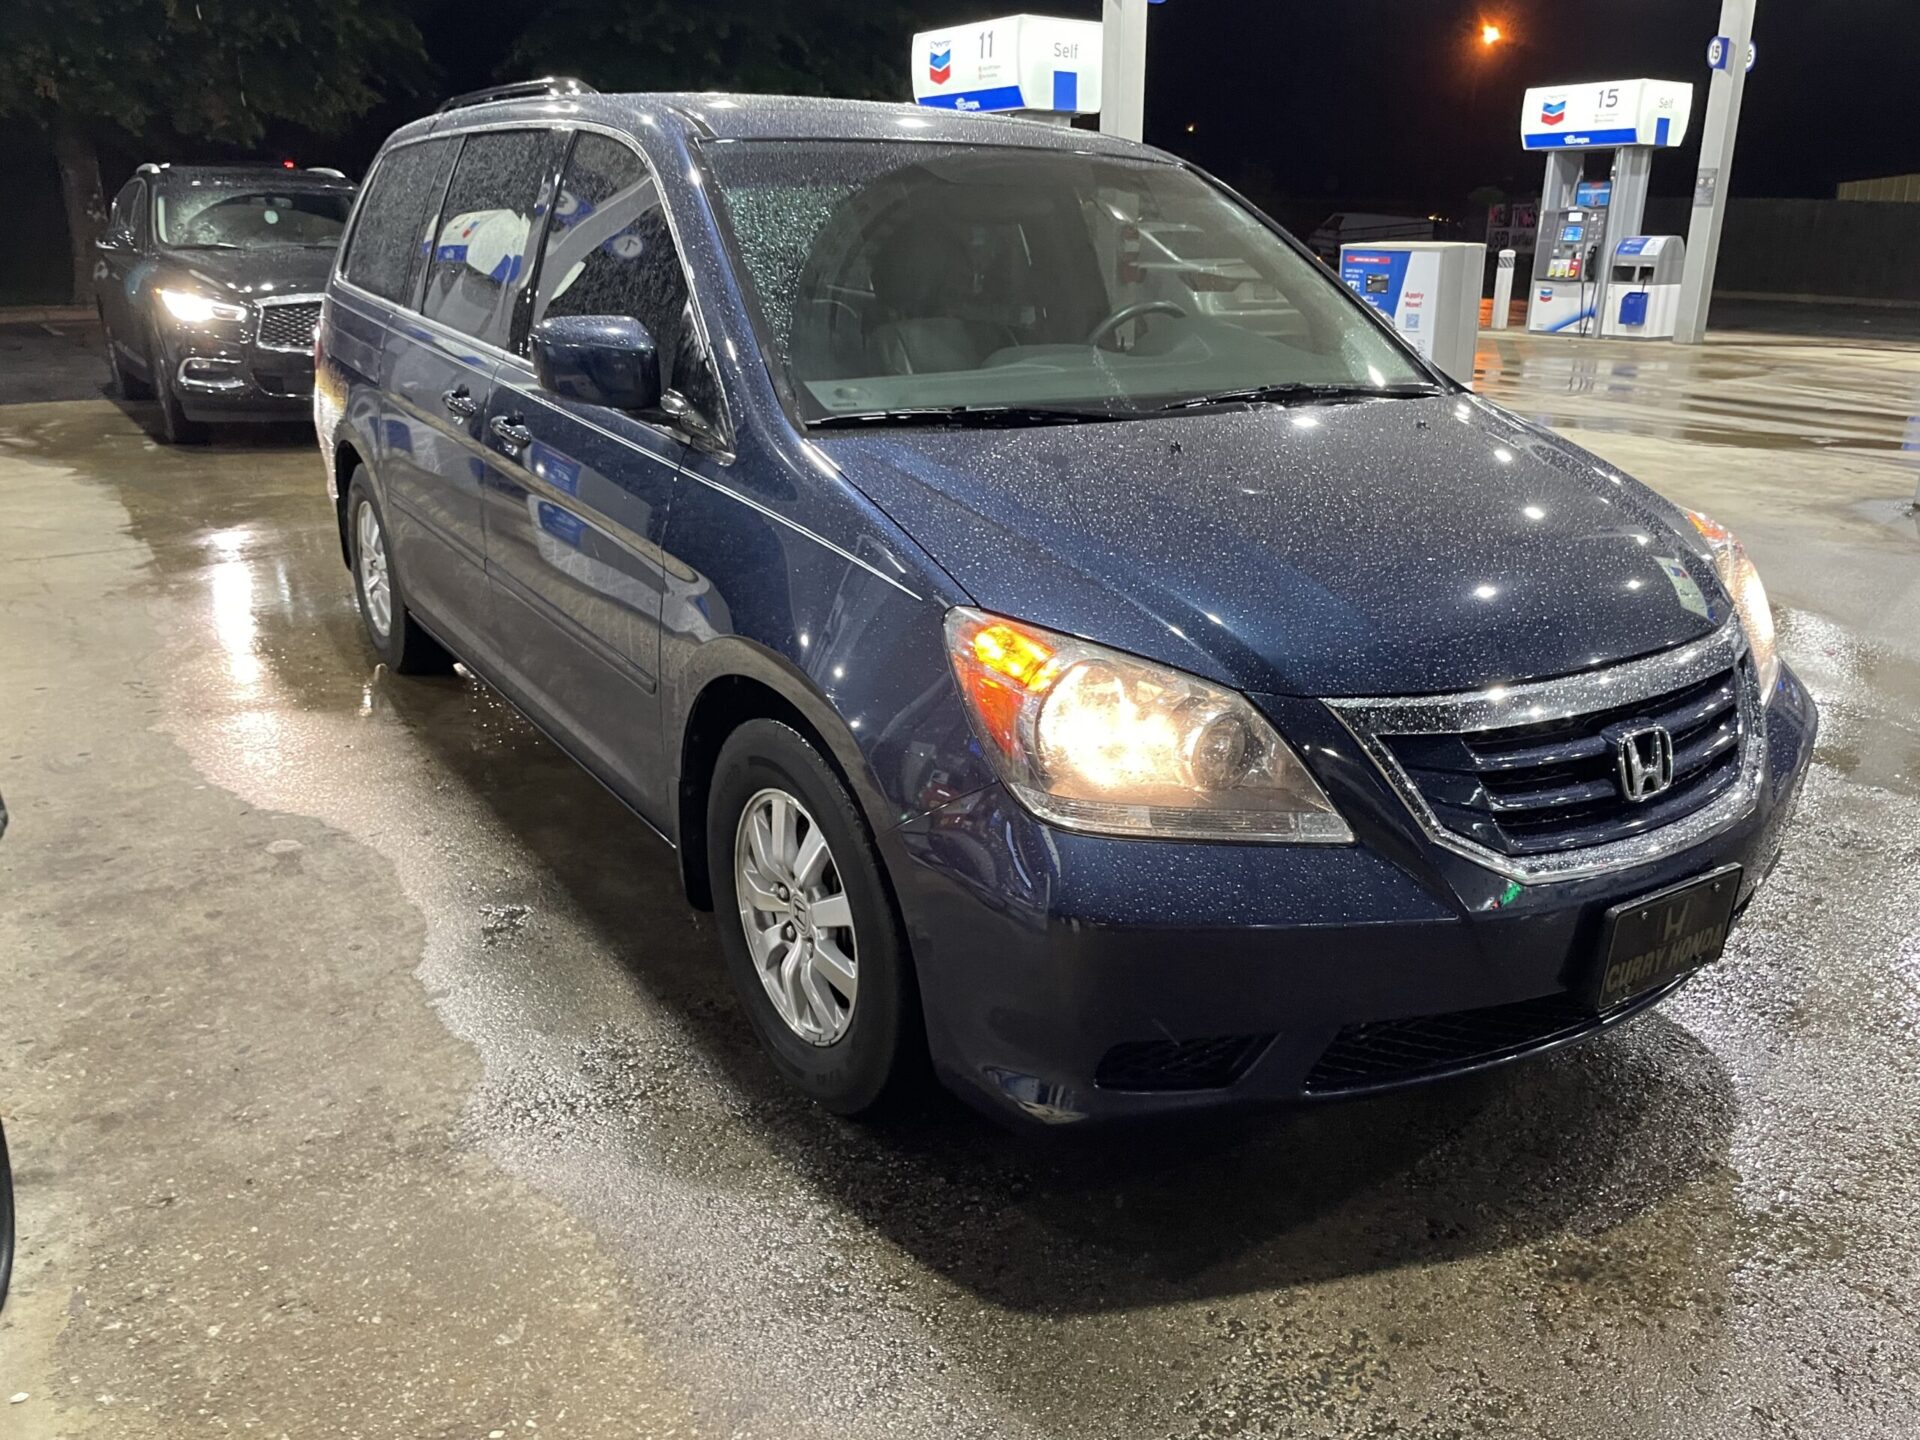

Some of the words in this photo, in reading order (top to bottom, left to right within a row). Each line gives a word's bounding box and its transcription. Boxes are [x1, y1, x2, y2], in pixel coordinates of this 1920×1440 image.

[979, 31, 994, 59] 11
[1053, 42, 1079, 60] Self
[1711, 45, 1720, 60] 15
[1598, 88, 1619, 109] 15
[1659, 97, 1674, 109] Self
[1405, 291, 1424, 300] Apply
[1606, 948, 1667, 993] CURRY
[1665, 923, 1723, 967] HONDA
